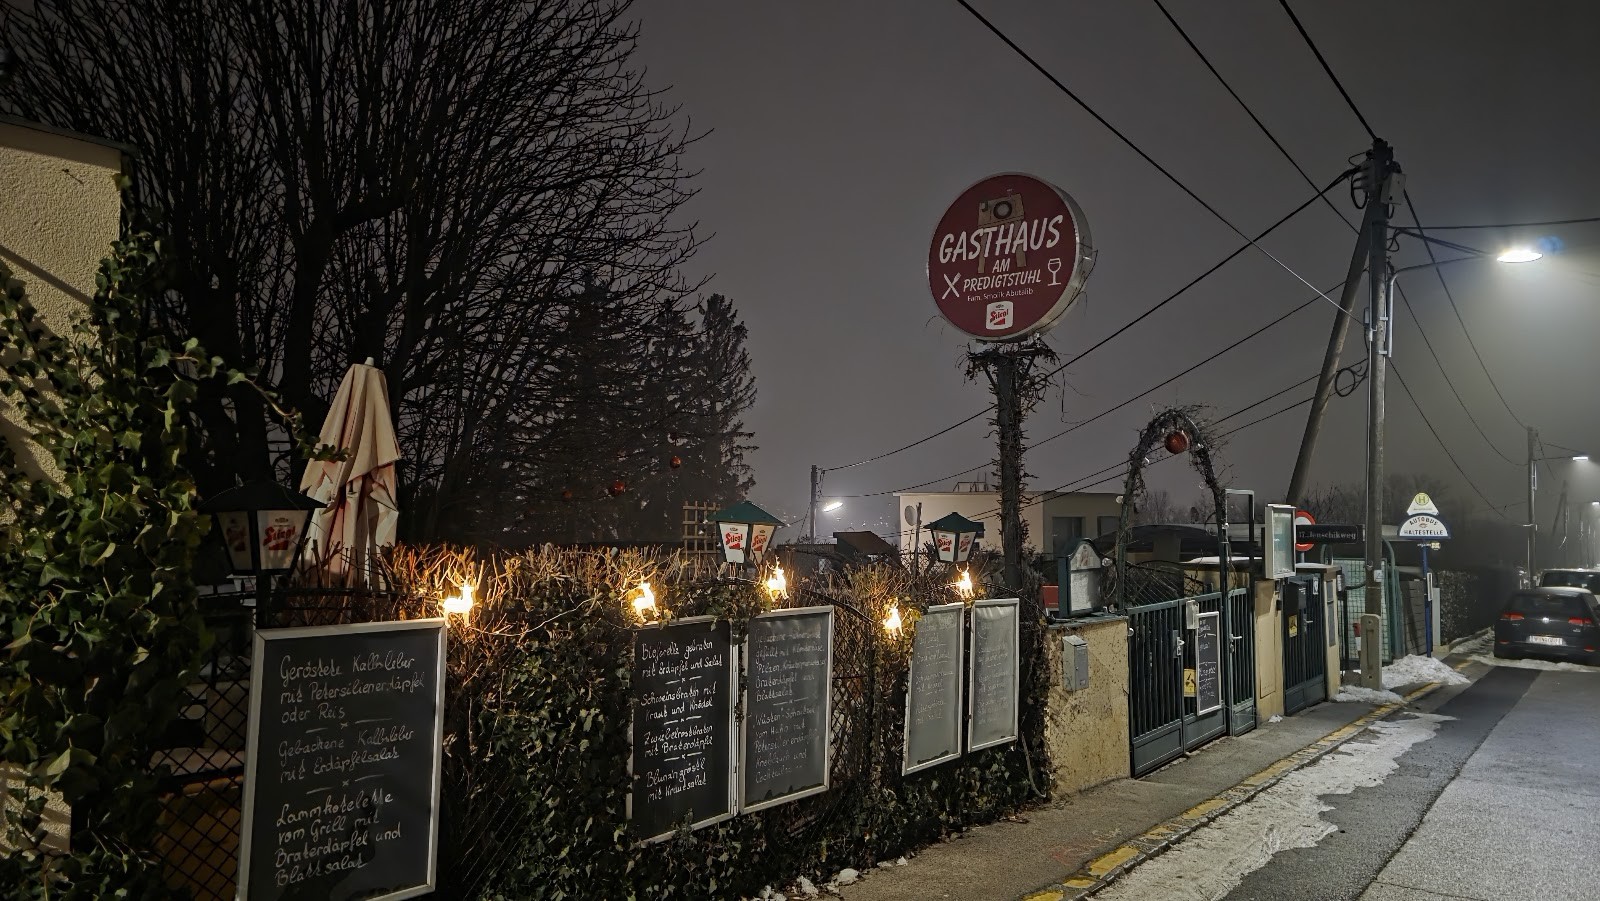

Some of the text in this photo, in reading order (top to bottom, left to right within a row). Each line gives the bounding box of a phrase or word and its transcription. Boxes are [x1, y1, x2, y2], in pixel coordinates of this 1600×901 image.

[940, 215, 1063, 264] GASTHAUS
[992, 258, 1011, 274] AM
[963, 268, 1042, 292] PREDIGTSTUHL
[1005, 287, 1034, 298] Abutalib
[1409, 516, 1438, 526] AUTOBUS
[281, 655, 342, 687] Geröstete
[642, 662, 656, 679] mit
[690, 658, 702, 670] und
[704, 653, 722, 667] Salat
[281, 683, 303, 705] mit
[641, 681, 716, 706] Schweinsbraten mit
[281, 702, 345, 724] oder Reis
[646, 696, 712, 722] Kraut und Knödel
[279, 738, 344, 767] Gebackene
[645, 743, 658, 758] mit
[281, 750, 399, 784] mit Erdäpfelsalat
[647, 771, 706, 803] mit Krautsalat
[276, 788, 394, 827] Lammkotelette
[278, 810, 379, 845] vom Grill mit
[275, 820, 401, 868] Braterdäpfel und
[275, 853, 366, 887] Blattsalat
